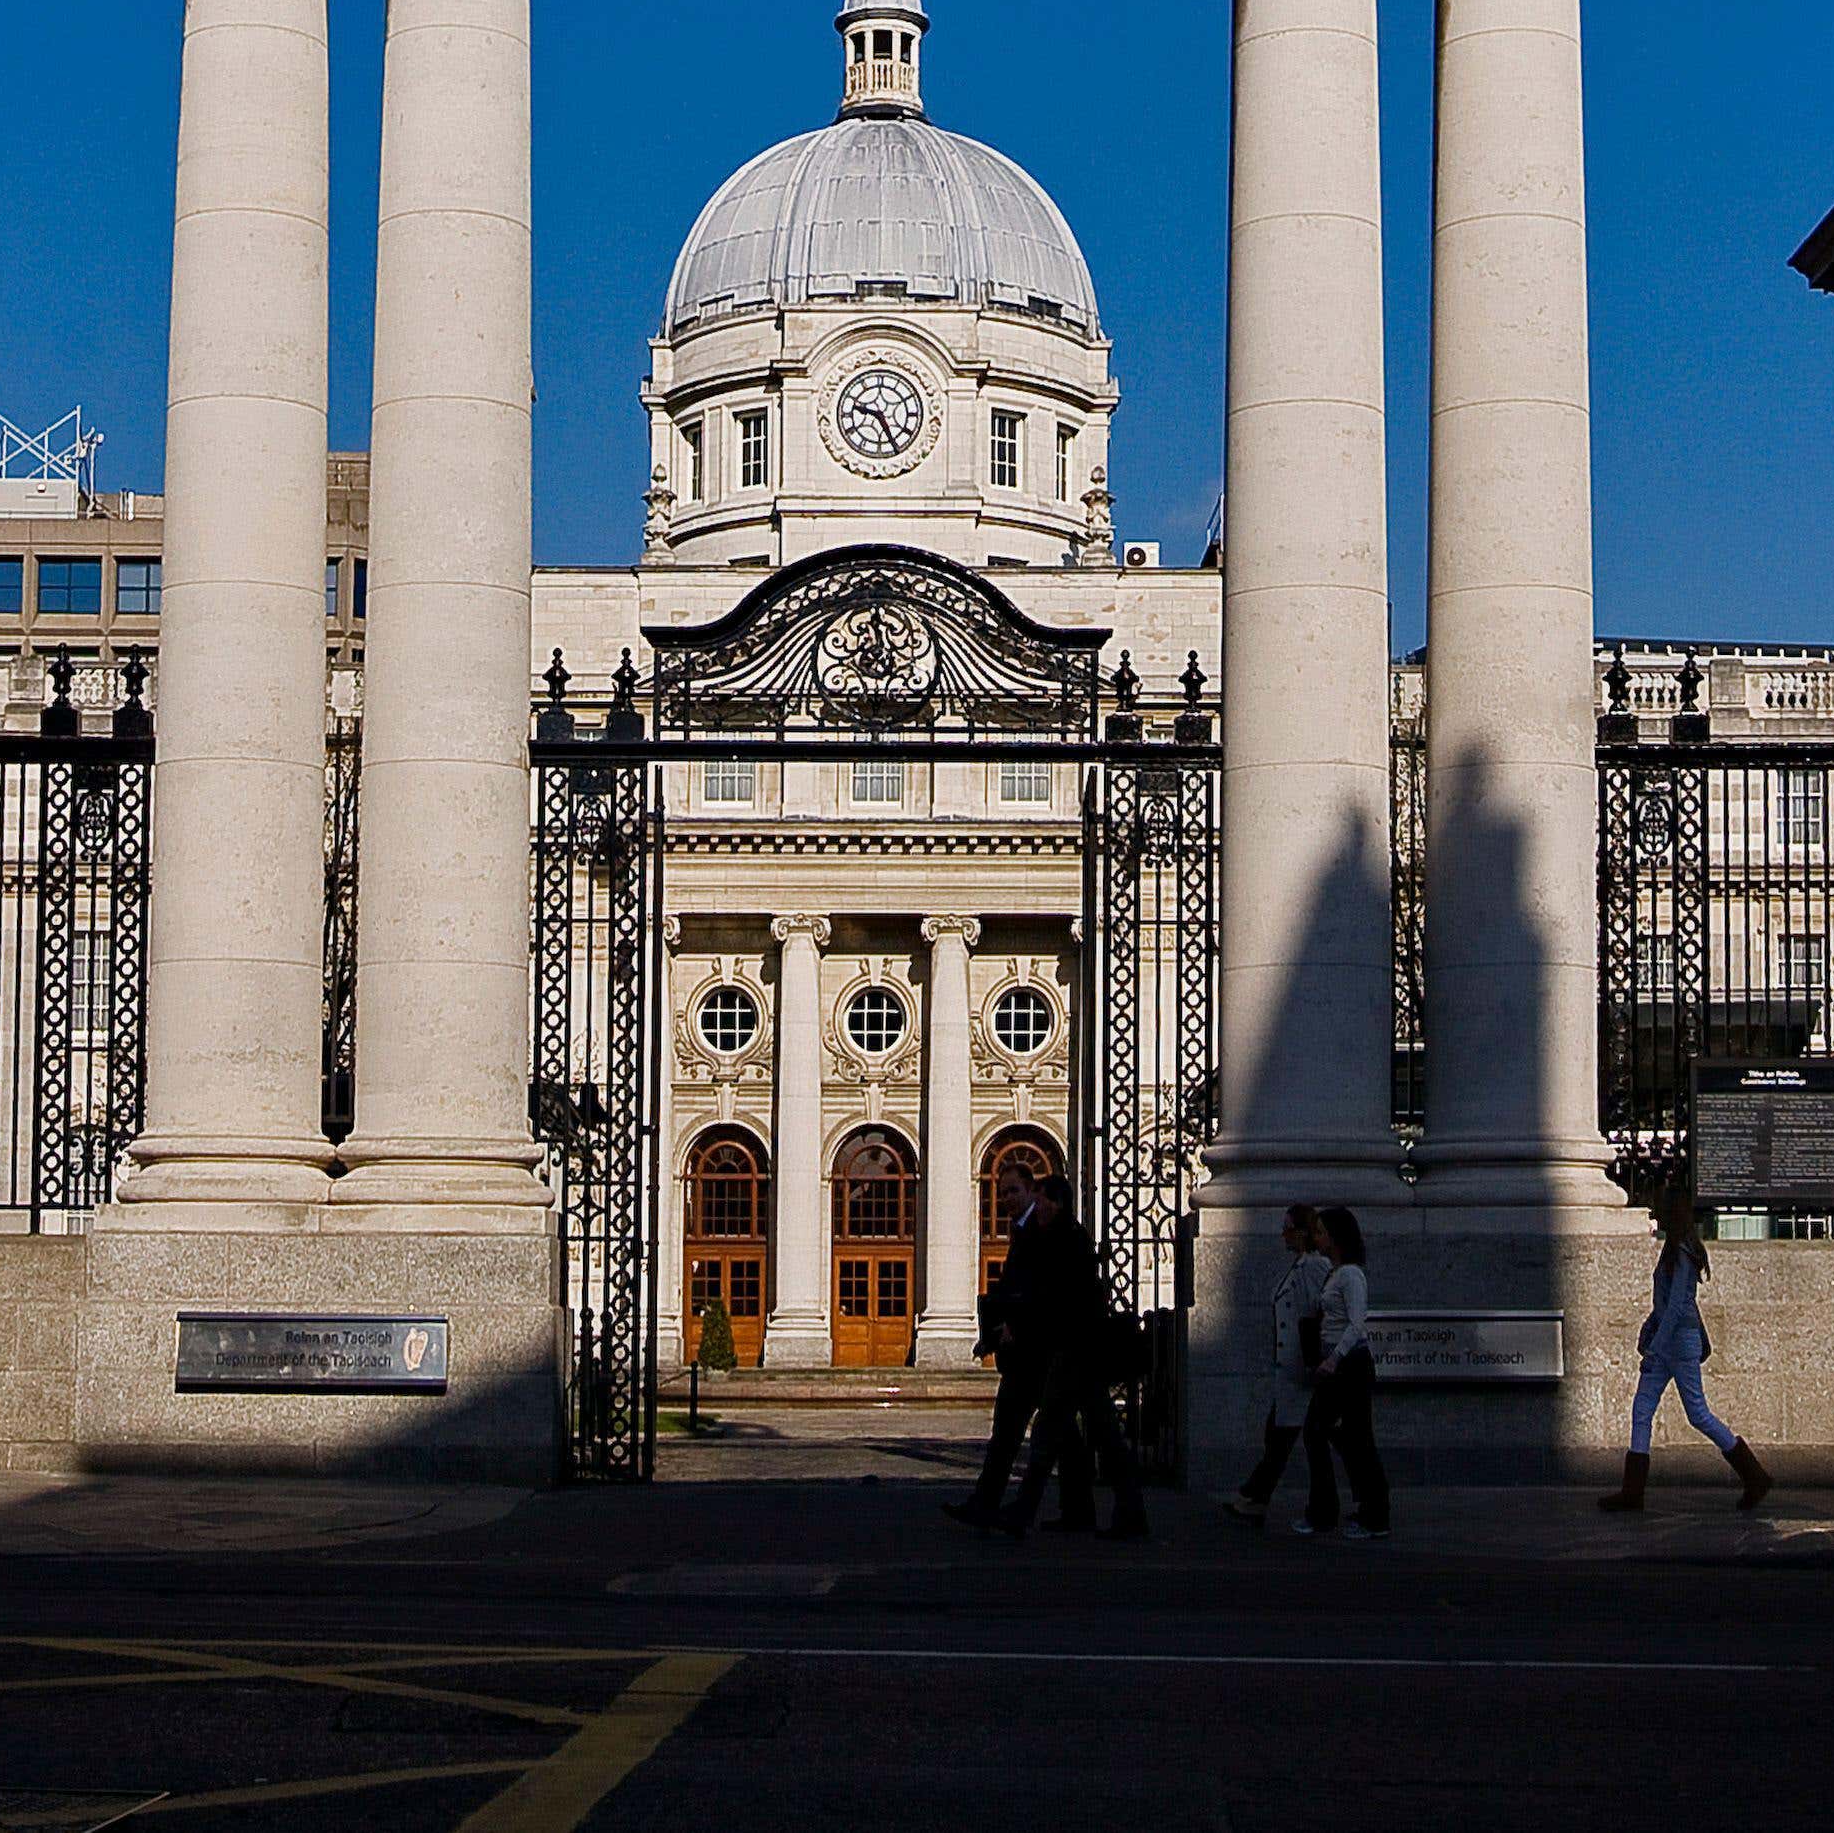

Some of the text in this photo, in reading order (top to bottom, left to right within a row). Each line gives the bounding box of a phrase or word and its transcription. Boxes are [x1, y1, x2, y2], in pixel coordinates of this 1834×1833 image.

[285, 1330, 393, 1347] Roinn an Taoisigh
[1386, 1331, 1402, 1342] an
[215, 1353, 393, 1369] Department of the Taoiseach
[1424, 1349, 1439, 1365] of
[1440, 1350, 1462, 1365] the
[1466, 1349, 1526, 1365] Taoiseach
